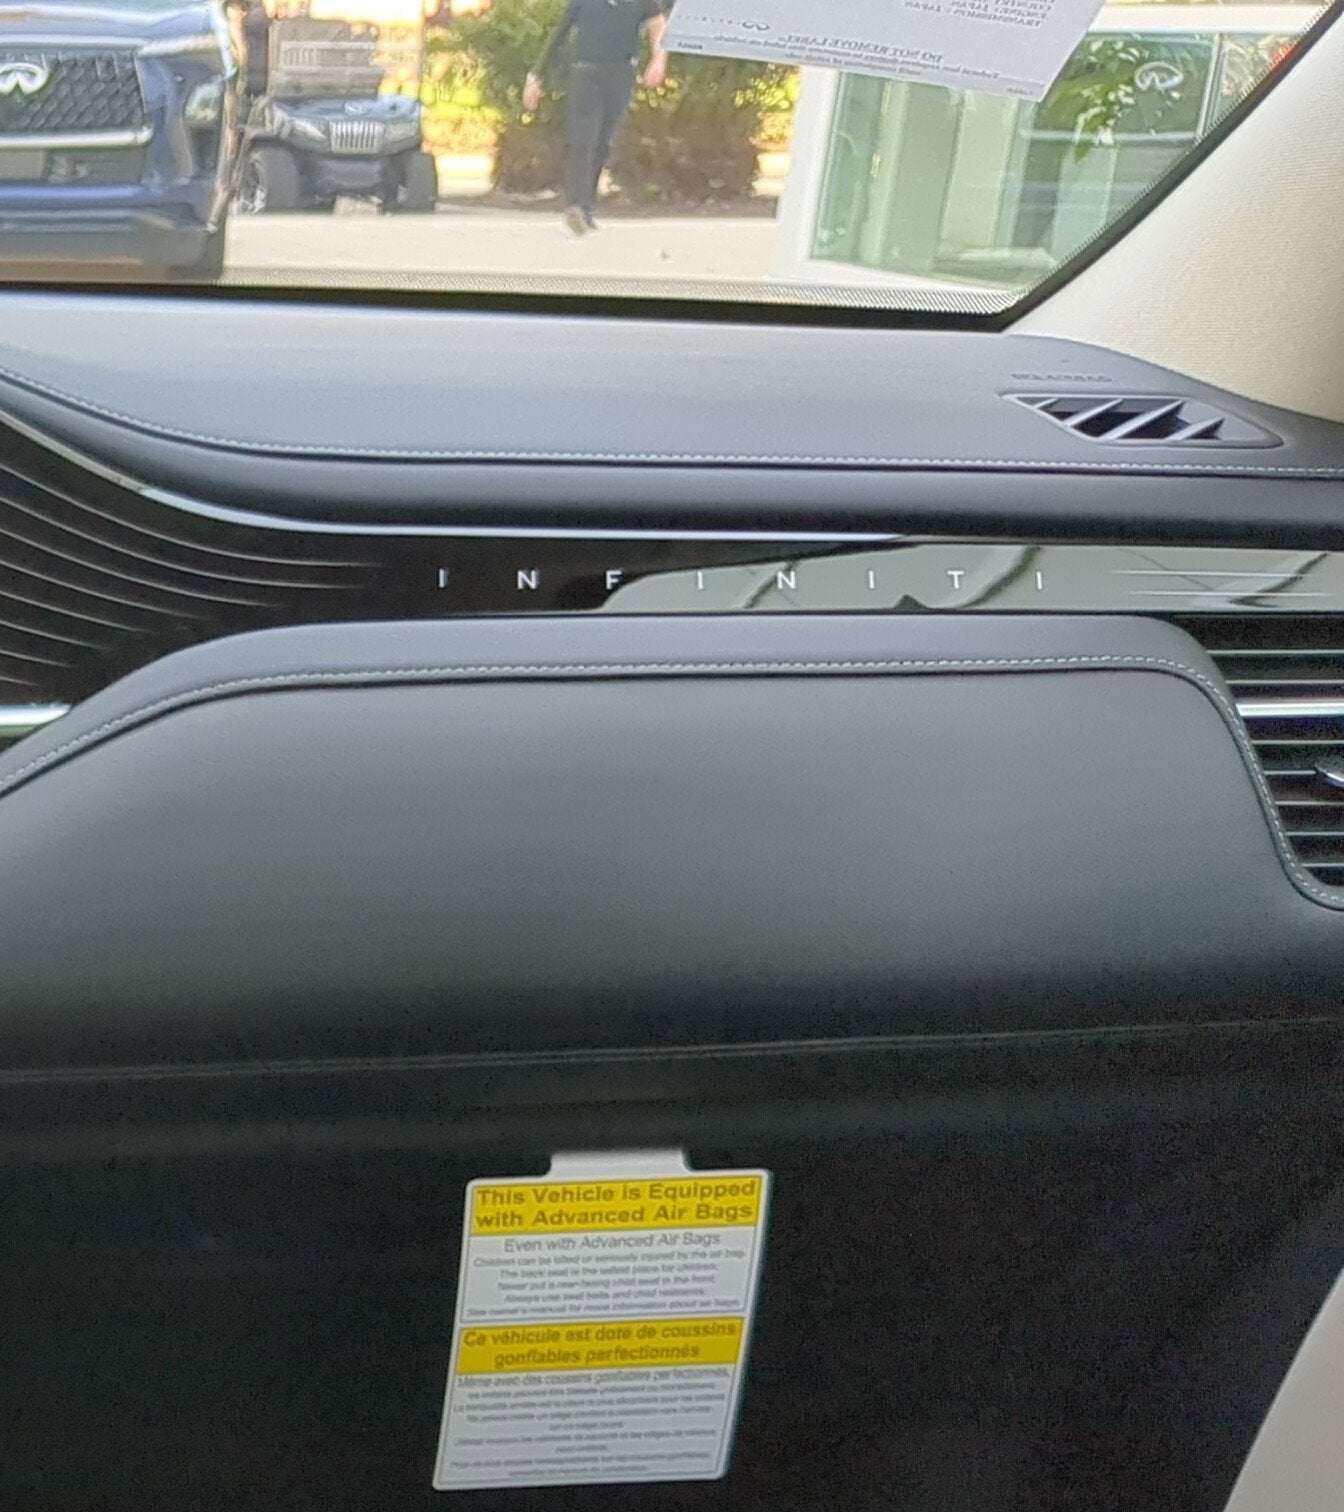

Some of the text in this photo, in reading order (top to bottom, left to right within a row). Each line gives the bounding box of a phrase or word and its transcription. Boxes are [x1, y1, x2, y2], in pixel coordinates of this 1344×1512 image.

[438, 568, 1046, 591] INFINITI
[476, 1179, 757, 1206] This Vehicle is Equipped
[475, 1201, 754, 1229] with Advanced Air Bags
[503, 1231, 721, 1253] Even with Advanced Air Bags
[463, 1331, 486, 1347] Ce
[564, 1328, 592, 1343] est
[636, 1323, 657, 1339] de
[661, 1321, 737, 1338] coussins
[493, 1347, 582, 1369] gonflables
